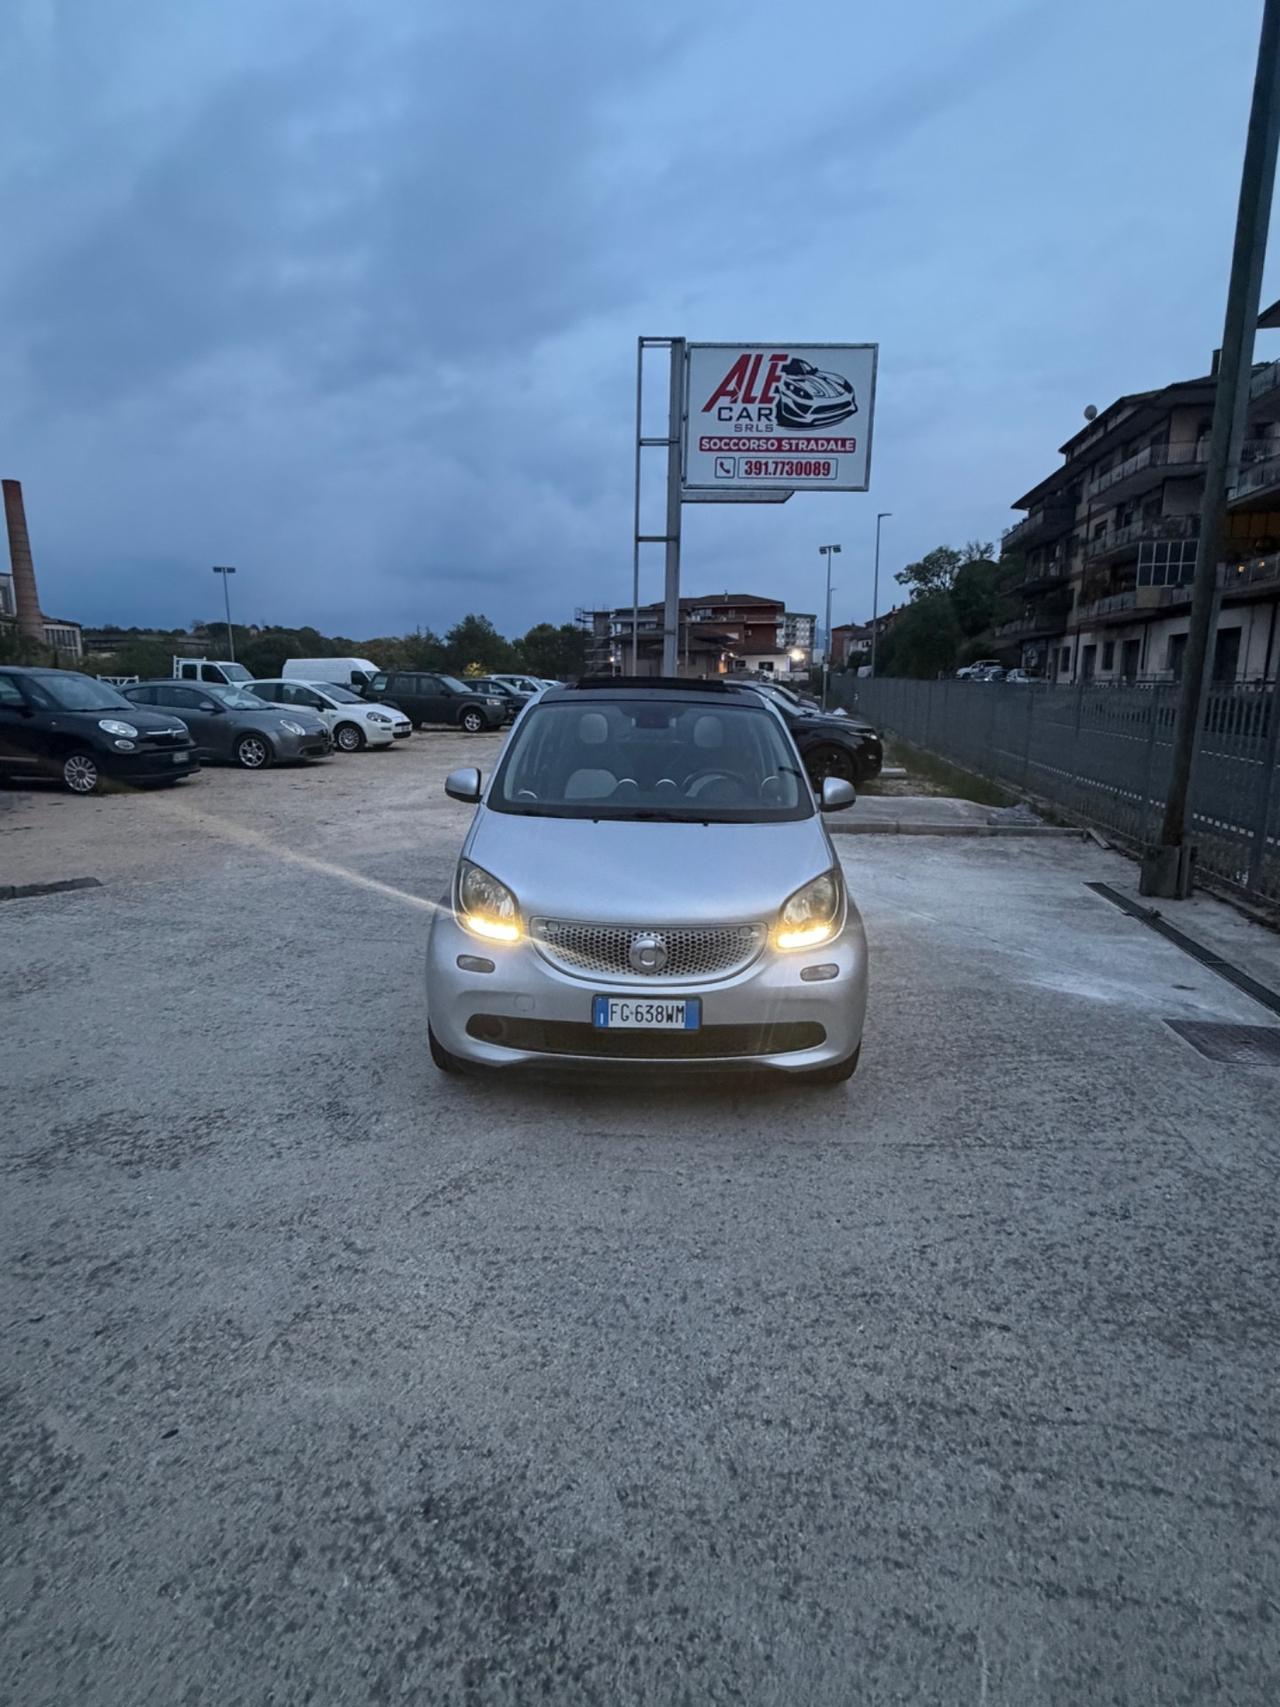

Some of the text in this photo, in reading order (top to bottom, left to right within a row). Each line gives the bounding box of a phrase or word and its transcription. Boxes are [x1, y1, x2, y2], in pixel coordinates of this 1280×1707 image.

[701, 353, 789, 412] ALE
[717, 406, 774, 422] CAR
[734, 423, 774, 433] SRLS
[701, 438, 855, 452] SOCCORSO STRADALE
[744, 460, 831, 477] 391.7730089
